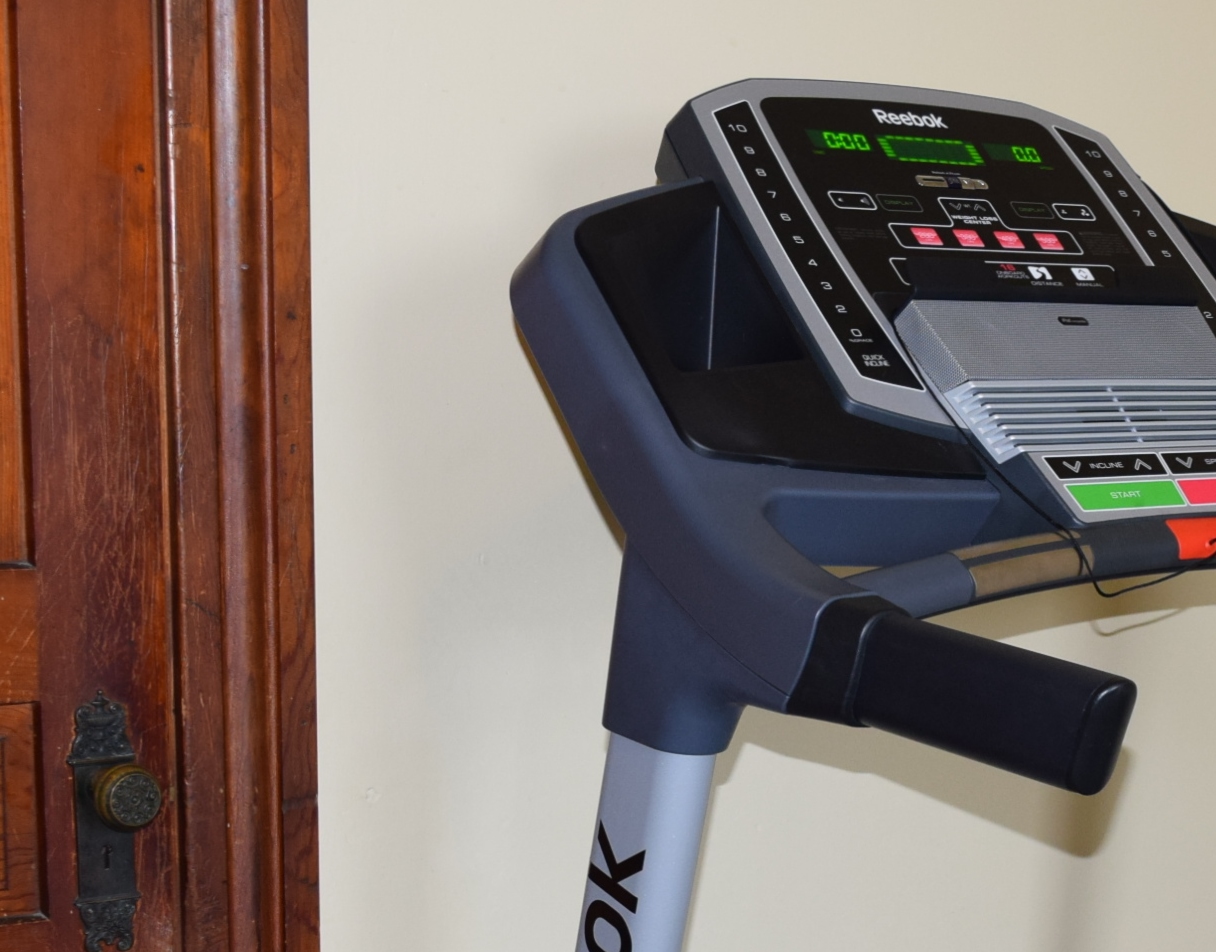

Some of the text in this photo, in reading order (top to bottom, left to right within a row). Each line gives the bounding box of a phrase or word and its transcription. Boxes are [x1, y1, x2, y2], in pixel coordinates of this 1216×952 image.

[872, 108, 949, 129] Reebok
[728, 123, 748, 133] 10
[822, 131, 871, 151] 0:00
[743, 146, 755, 155] 9
[1085, 149, 1101, 159] 10
[755, 168, 767, 177] 8
[1103, 170, 1113, 178] 9
[767, 191, 776, 199] 7
[1118, 190, 1129, 198] 8
[780, 213, 791, 222] 6
[1147, 229, 1158, 238] 6
[793, 235, 804, 244] 5
[1161, 249, 1172, 258] 5
[808, 259, 818, 267] 4
[821, 281, 832, 290] 3
[836, 304, 848, 313] 2
[1203, 311, 1214, 319] 2
[851, 328, 863, 337] 0
[1089, 461, 1124, 469] INCLINE
[1109, 490, 1141, 499] START
